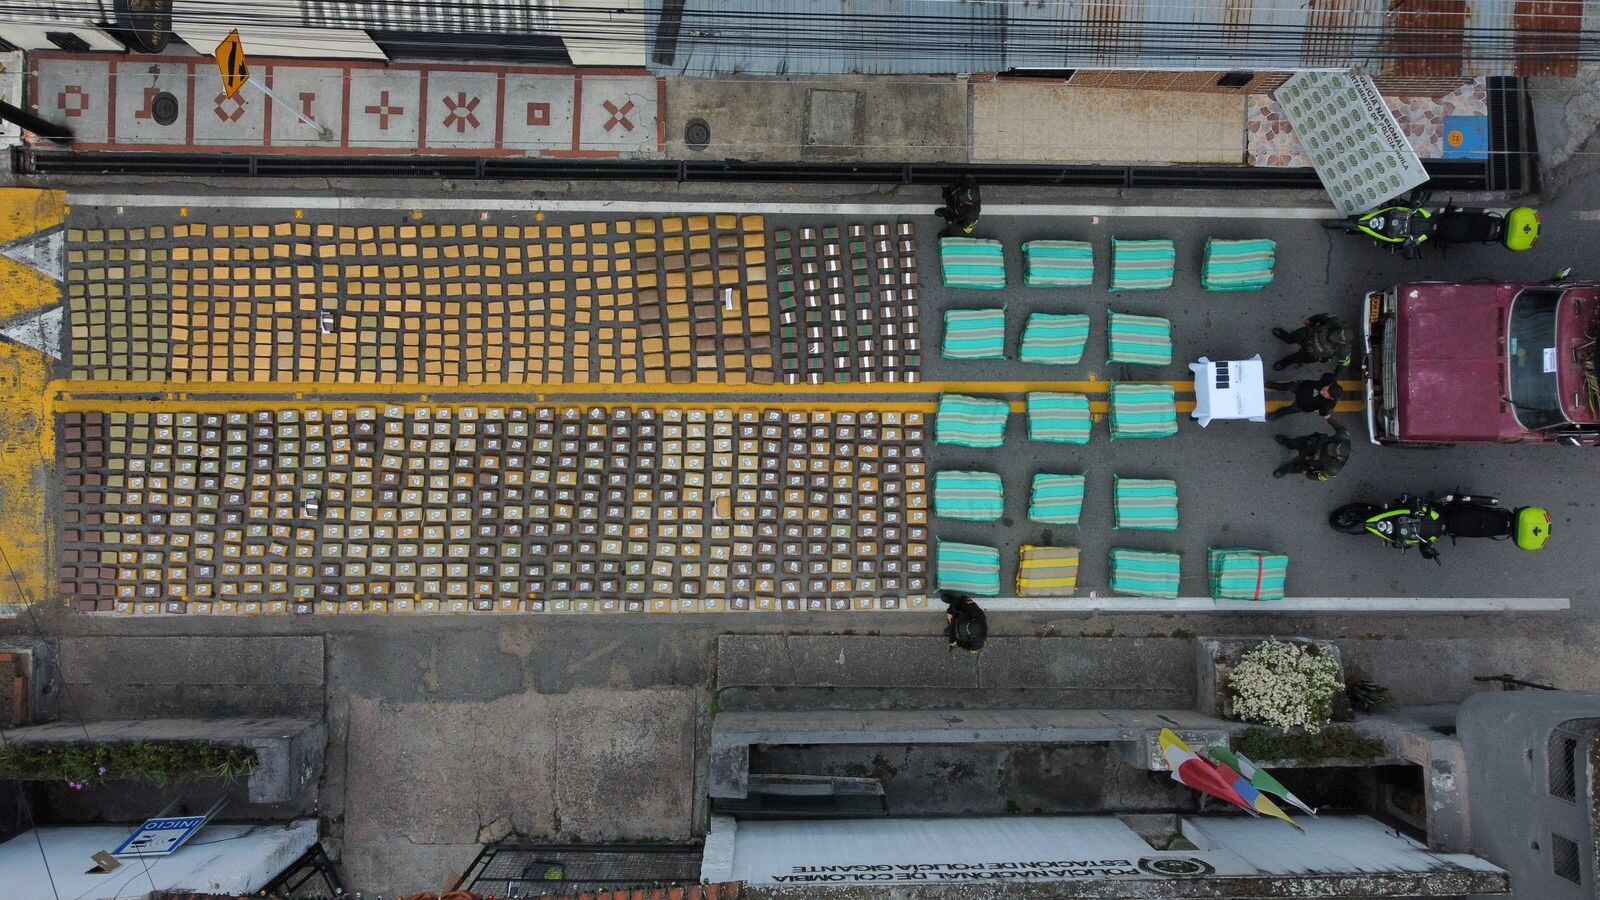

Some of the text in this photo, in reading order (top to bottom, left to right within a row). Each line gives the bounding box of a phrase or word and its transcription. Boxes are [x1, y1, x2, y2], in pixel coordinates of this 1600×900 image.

[1370, 112, 1379, 121] DE
[1375, 107, 1405, 151] NACIONAL
[145, 820, 199, 829] INICIO
[792, 864, 893, 873] GIGANTE
[895, 863, 983, 872] POLICÍA
[984, 861, 1018, 869] DE
[772, 873, 893, 882] COLOMBIA
[895, 872, 927, 880] DE
[930, 868, 1049, 880] NACIONAL
